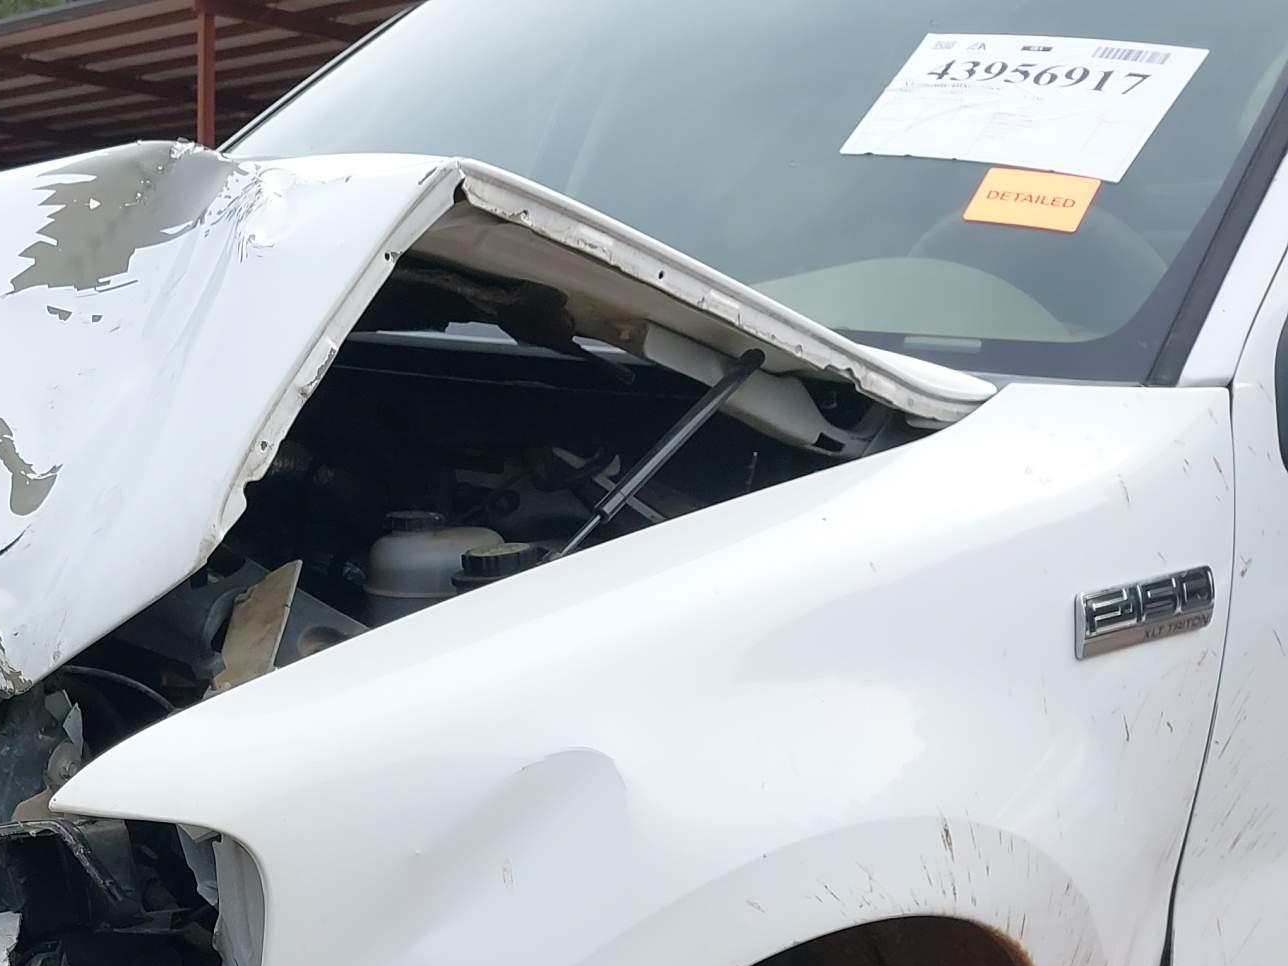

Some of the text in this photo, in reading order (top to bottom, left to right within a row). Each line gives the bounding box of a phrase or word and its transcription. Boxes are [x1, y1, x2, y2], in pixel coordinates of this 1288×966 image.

[926, 58, 1153, 96] 43956917
[985, 188, 1077, 210] DETAILED
[1168, 613, 1210, 634] TRITON
